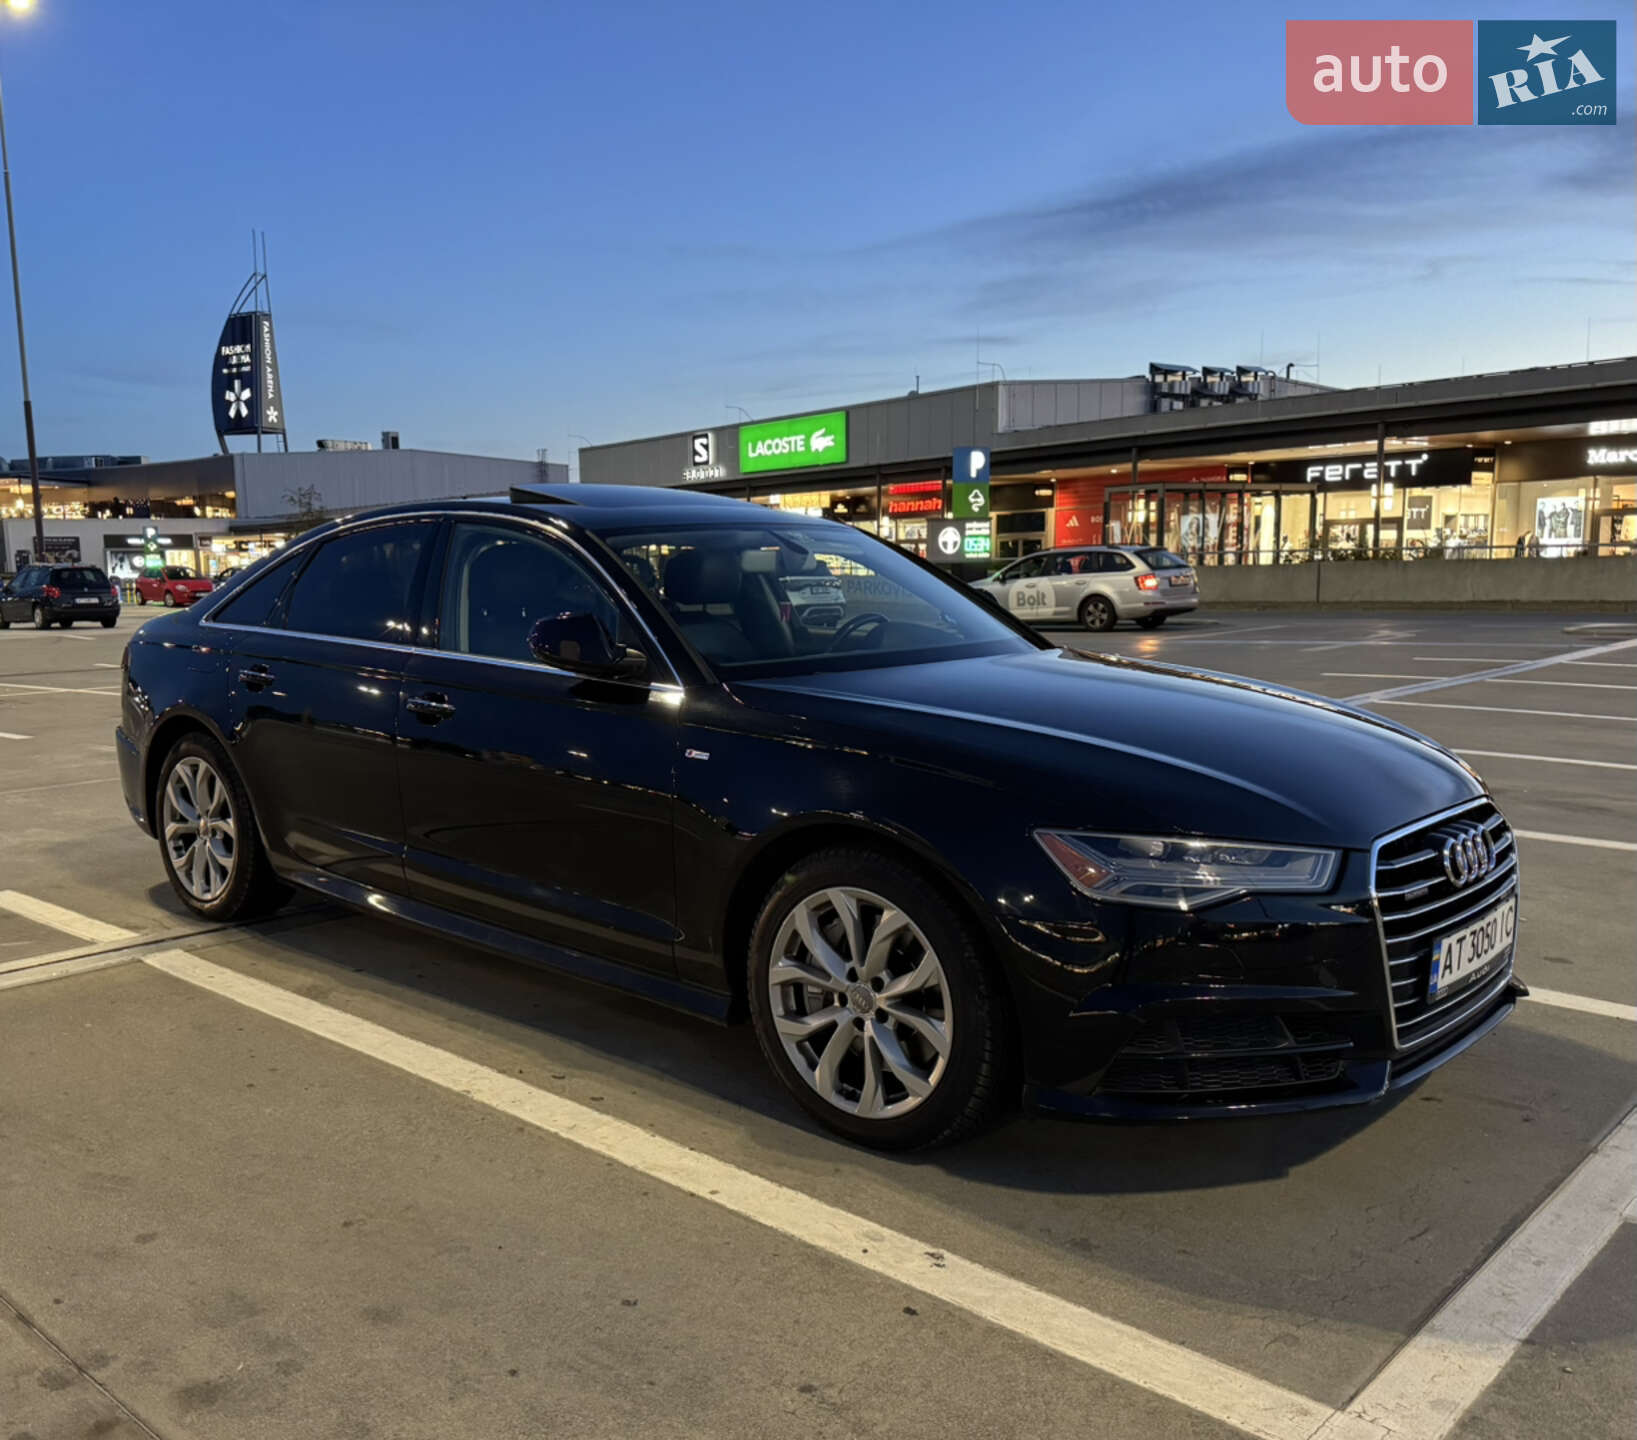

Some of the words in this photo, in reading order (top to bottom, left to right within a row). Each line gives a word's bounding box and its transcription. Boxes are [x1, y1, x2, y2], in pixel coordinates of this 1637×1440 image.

[262, 320, 272, 364] FASHION
[265, 366, 274, 400] ARENA
[694, 438, 708, 463] S
[747, 434, 805, 458] LACOSTE
[969, 449, 986, 479] P
[888, 497, 943, 513] hannah
[1016, 591, 1047, 608] Bolt
[1441, 935, 1467, 979] AT
[1467, 917, 1497, 963] 3050
[1500, 906, 1513, 942] IC
